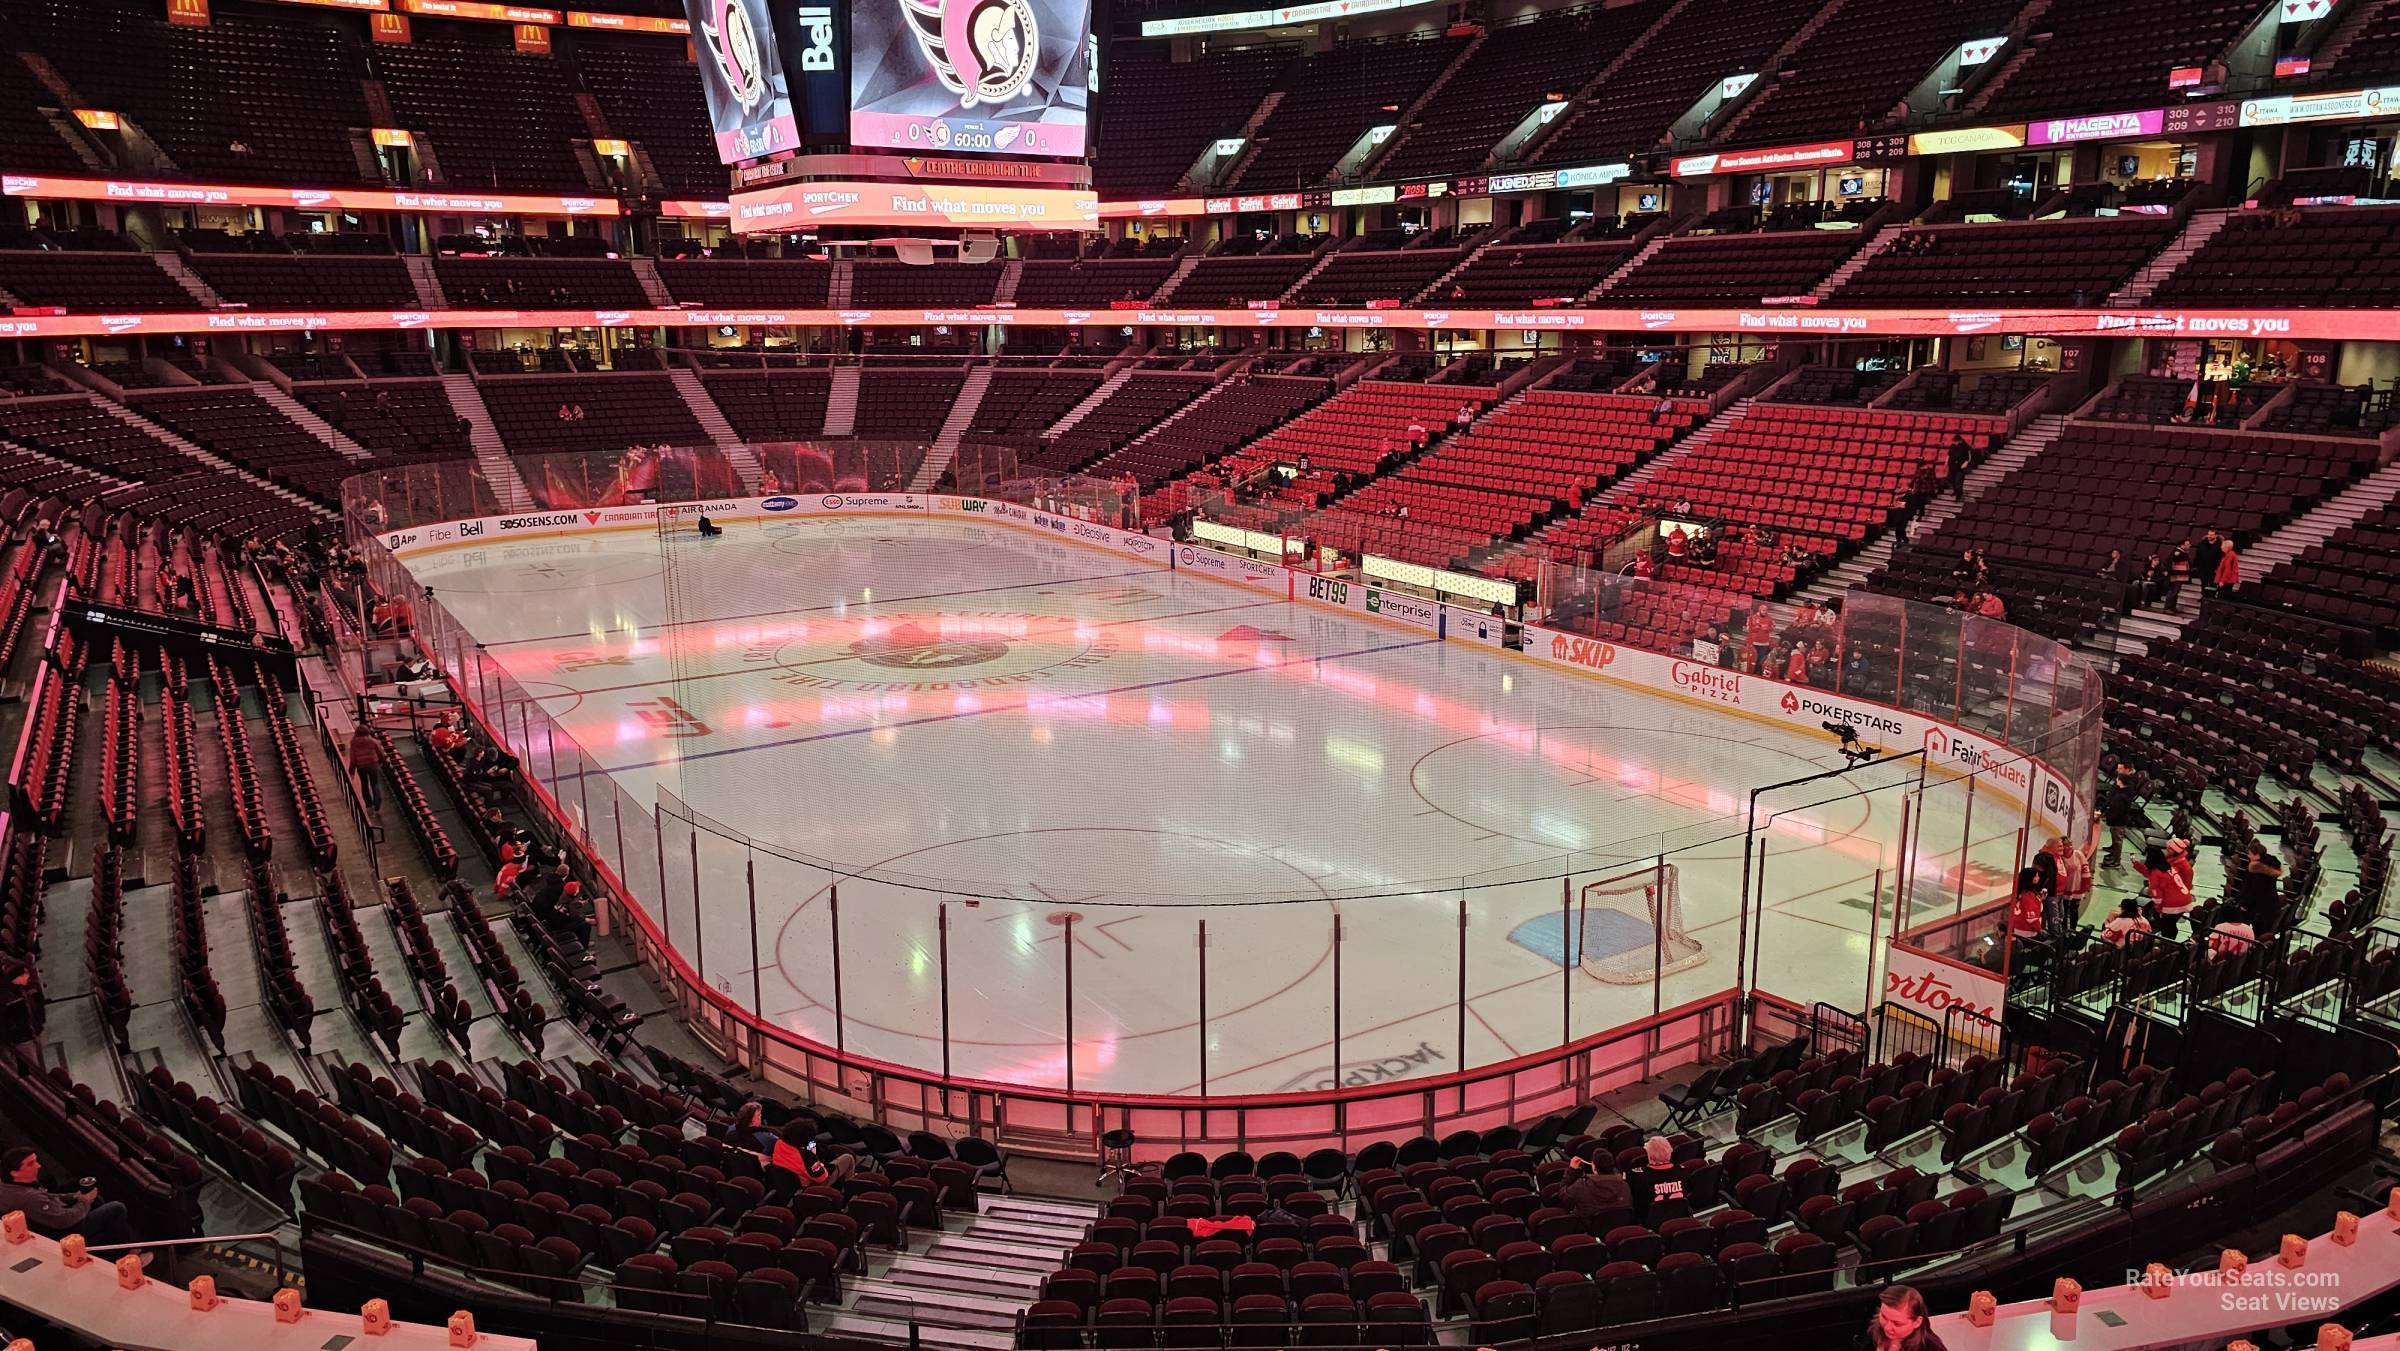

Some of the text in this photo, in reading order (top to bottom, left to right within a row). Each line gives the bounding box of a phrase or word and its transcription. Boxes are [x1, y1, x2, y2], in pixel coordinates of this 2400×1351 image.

[1292, 7, 1319, 17] CANADIAN
[799, 7, 834, 71] Bell
[2169, 104, 2234, 118] 309 310
[2066, 115, 2141, 131] MAGENTA
[2168, 117, 2233, 131] 209 210
[909, 124, 919, 140] 0
[1025, 130, 1035, 146] 0
[1957, 134, 1994, 143] CANADA
[954, 133, 991, 148] 60:00
[1889, 148, 1903, 156] 209
[1599, 169, 1626, 179] MINOLT
[107, 184, 227, 201] Find what moves you
[292, 190, 330, 199] SPORTCHEK
[1405, 185, 1427, 195] ROSS
[395, 195, 502, 210] Find what moves you
[803, 192, 859, 204] SPORTCHEK
[1207, 200, 1230, 209] Gabriel
[1239, 198, 1263, 209] Gabriel
[1271, 196, 1297, 207] Gabriel
[740, 205, 753, 219] Find
[892, 195, 1046, 218] Find what moves you
[101, 317, 141, 325] SPORTCHEK
[209, 316, 326, 329] Find what moves you
[392, 313, 430, 321] SPORTCHEK
[688, 313, 709, 322] Find
[711, 313, 734, 322] what
[767, 315, 785, 324] you
[924, 312, 944, 321] Find
[946, 312, 968, 321] what
[997, 314, 1013, 323] you
[1138, 313, 1215, 323] Find what moves you
[1316, 313, 1382, 324] Find what moves you
[1495, 313, 1584, 326] Find what moves you
[1740, 313, 1867, 330] Find what moves you
[16, 321, 37, 334] you
[2097, 316, 2290, 335] Find what moves you
[2306, 355, 2326, 363] 108
[681, 504, 737, 514] AIR CANADA
[846, 497, 889, 507] Supreme
[939, 499, 988, 512] SUBWAY
[499, 514, 577, 530] 5050SENS.COM
[604, 511, 643, 522] CANADIAN
[429, 521, 484, 542] Fibe Bell
[1081, 524, 1110, 543] Decisive
[1196, 553, 1225, 568] Supreme
[1239, 559, 1275, 576] SPORTCHEK
[1309, 576, 1347, 605] BET99
[1368, 594, 1432, 619] enterprise
[1568, 638, 1616, 669] SKIP
[1671, 662, 1742, 694] Gabriel
[1692, 685, 1741, 705] PIZZA
[1802, 699, 1902, 735] POKERSTARS
[1951, 738, 2026, 789] FairSquare
[1654, 1181, 1683, 1195] STÜTZLE
